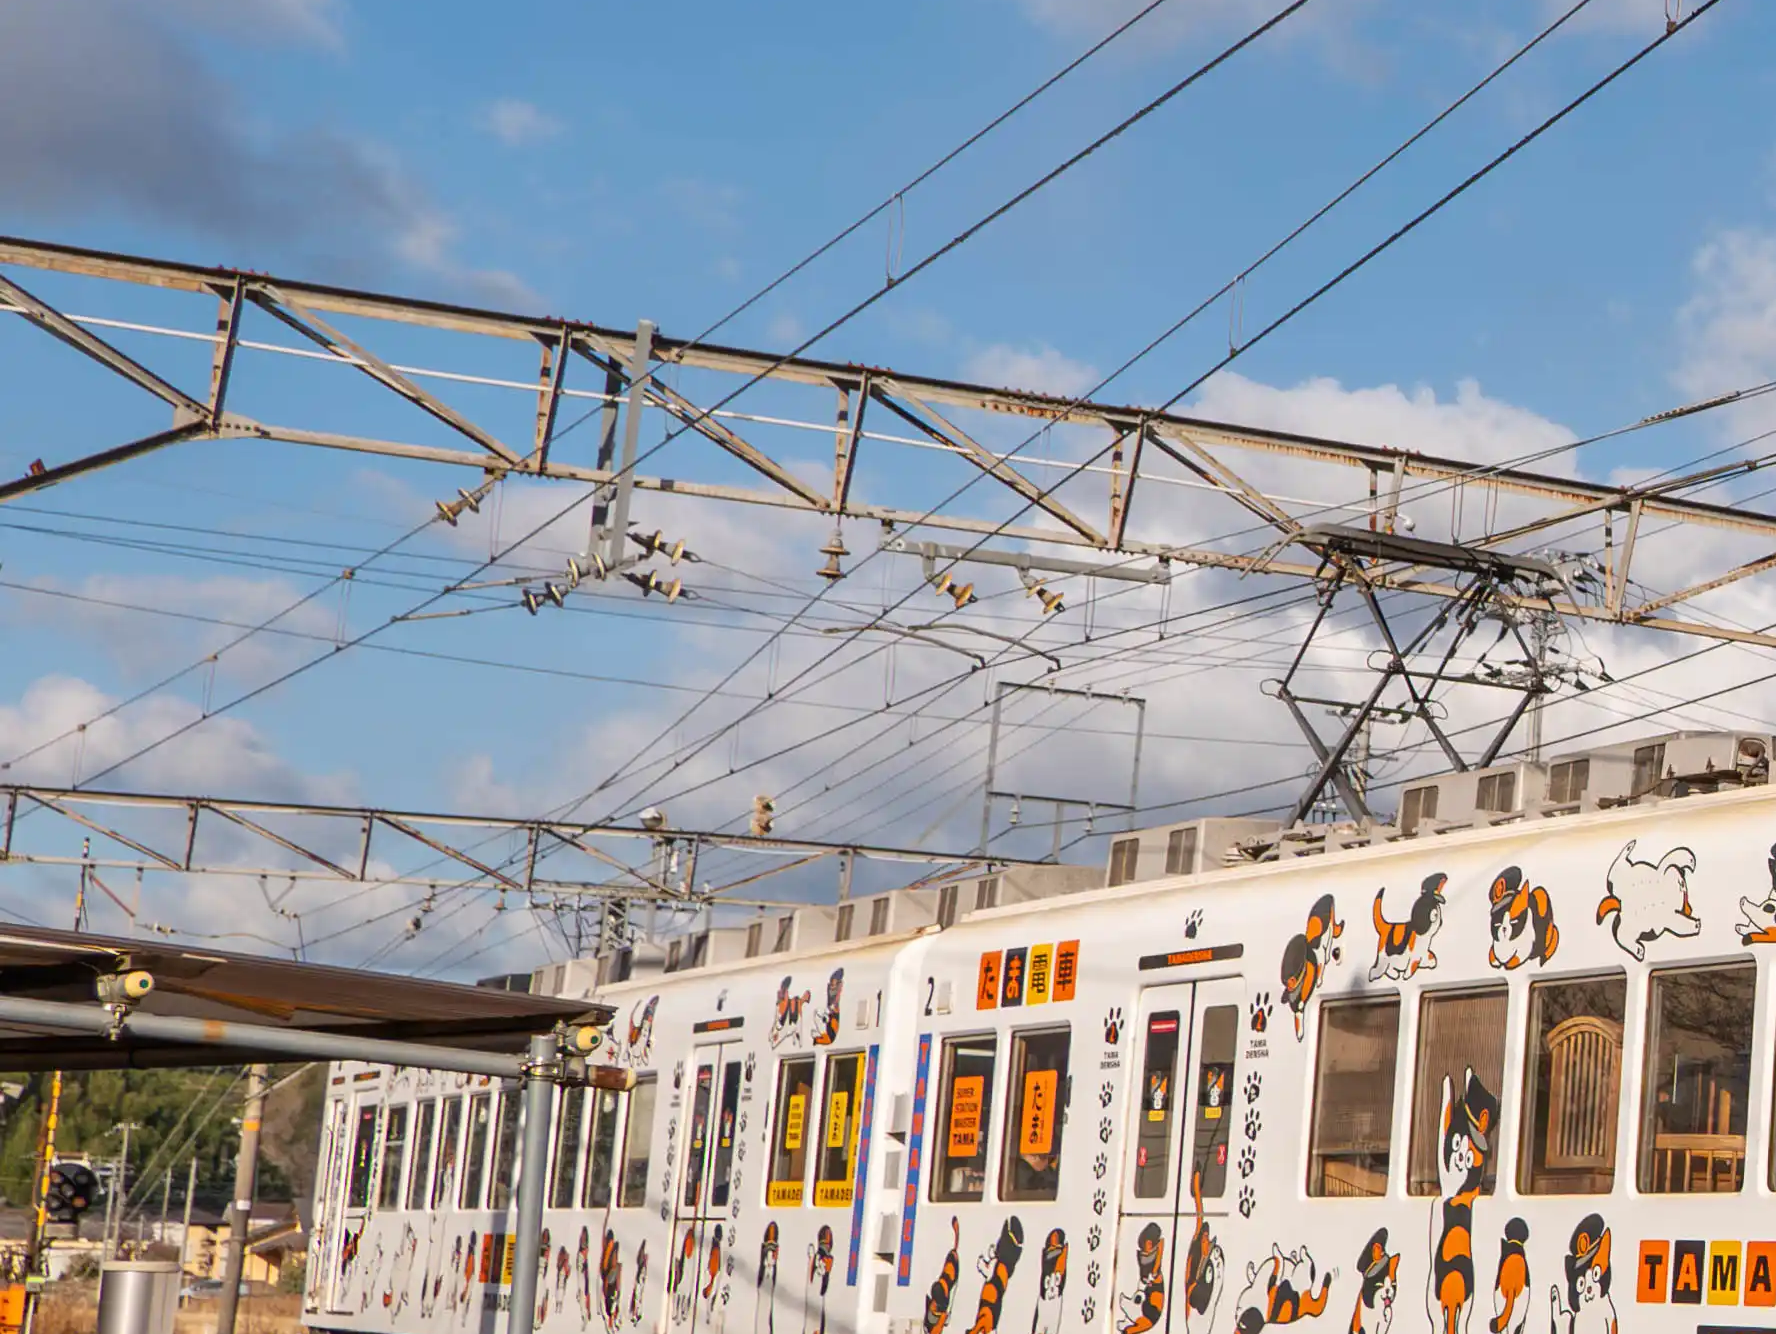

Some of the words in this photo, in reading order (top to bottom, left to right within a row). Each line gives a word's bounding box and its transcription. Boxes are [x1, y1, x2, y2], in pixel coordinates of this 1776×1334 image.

[924, 976, 935, 1017] 2
[980, 950, 1076, 1001] たま電車
[900, 1043, 930, 1278] TAMADEN
[953, 1132, 975, 1146] TAMA
